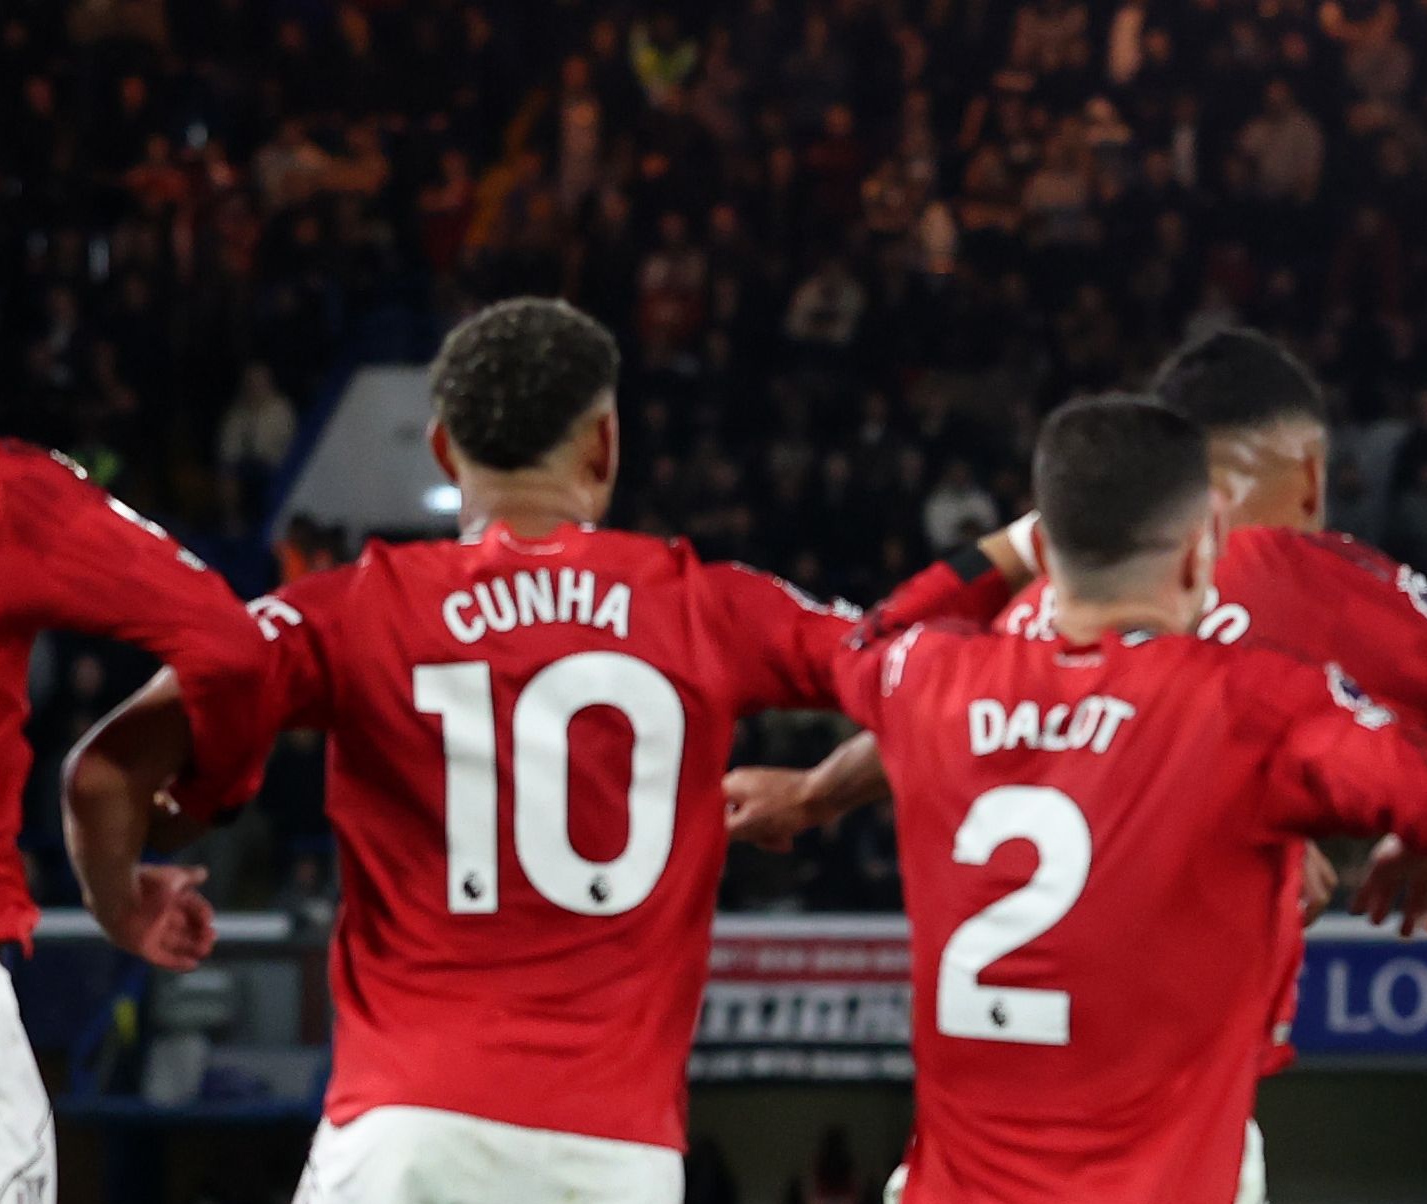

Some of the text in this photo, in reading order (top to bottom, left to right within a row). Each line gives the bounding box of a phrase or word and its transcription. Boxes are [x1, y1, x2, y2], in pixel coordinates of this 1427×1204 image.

[443, 567, 632, 645] CUNHA
[413, 651, 686, 916] 10
[968, 695, 1136, 756] DALOT
[936, 785, 1093, 1046] 2
